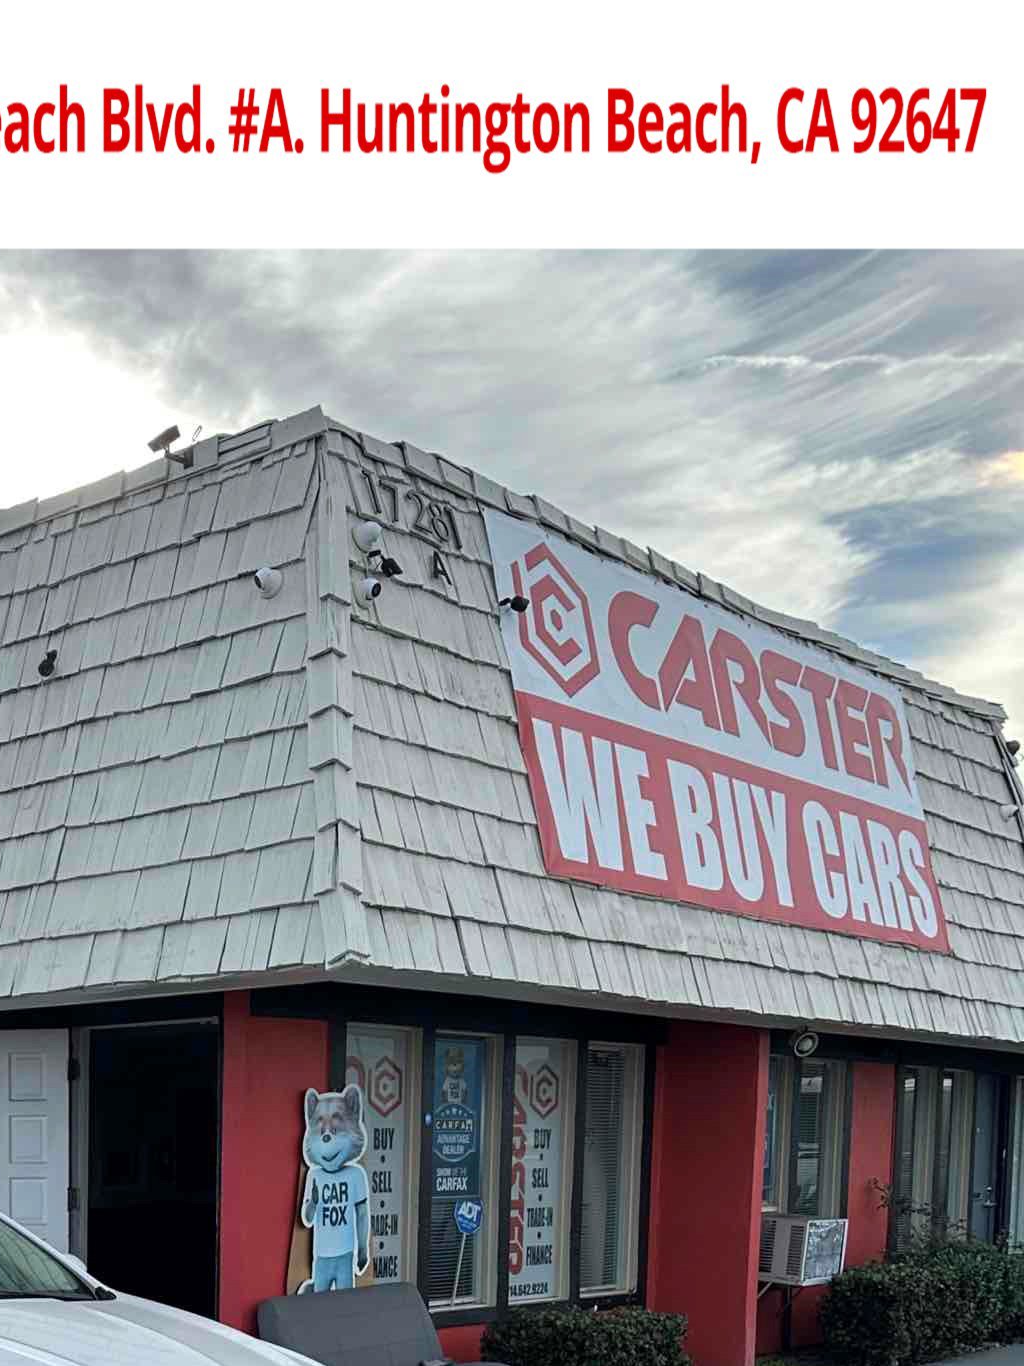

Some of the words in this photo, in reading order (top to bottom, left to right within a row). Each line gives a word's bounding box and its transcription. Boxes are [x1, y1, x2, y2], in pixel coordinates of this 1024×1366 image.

[362, 469, 462, 550] 17281
[433, 551, 452, 586] A
[608, 591, 916, 799] CARSTER
[532, 717, 668, 880] WE
[666, 758, 794, 907] BUY
[802, 800, 938, 938] CARS
[373, 1128, 395, 1150] BUY
[533, 1129, 552, 1149] BUY
[372, 1171, 392, 1193] SELL
[436, 1176, 468, 1191] CARFAX
[532, 1168, 549, 1188] SELL
[322, 1182, 348, 1204] CAR
[322, 1205, 348, 1226] FOX
[457, 1200, 481, 1222] ADT
[527, 1207, 553, 1228] TRADE-IN
[371, 1213, 398, 1237] RADE-IN
[526, 1246, 553, 1267] FINANCE
